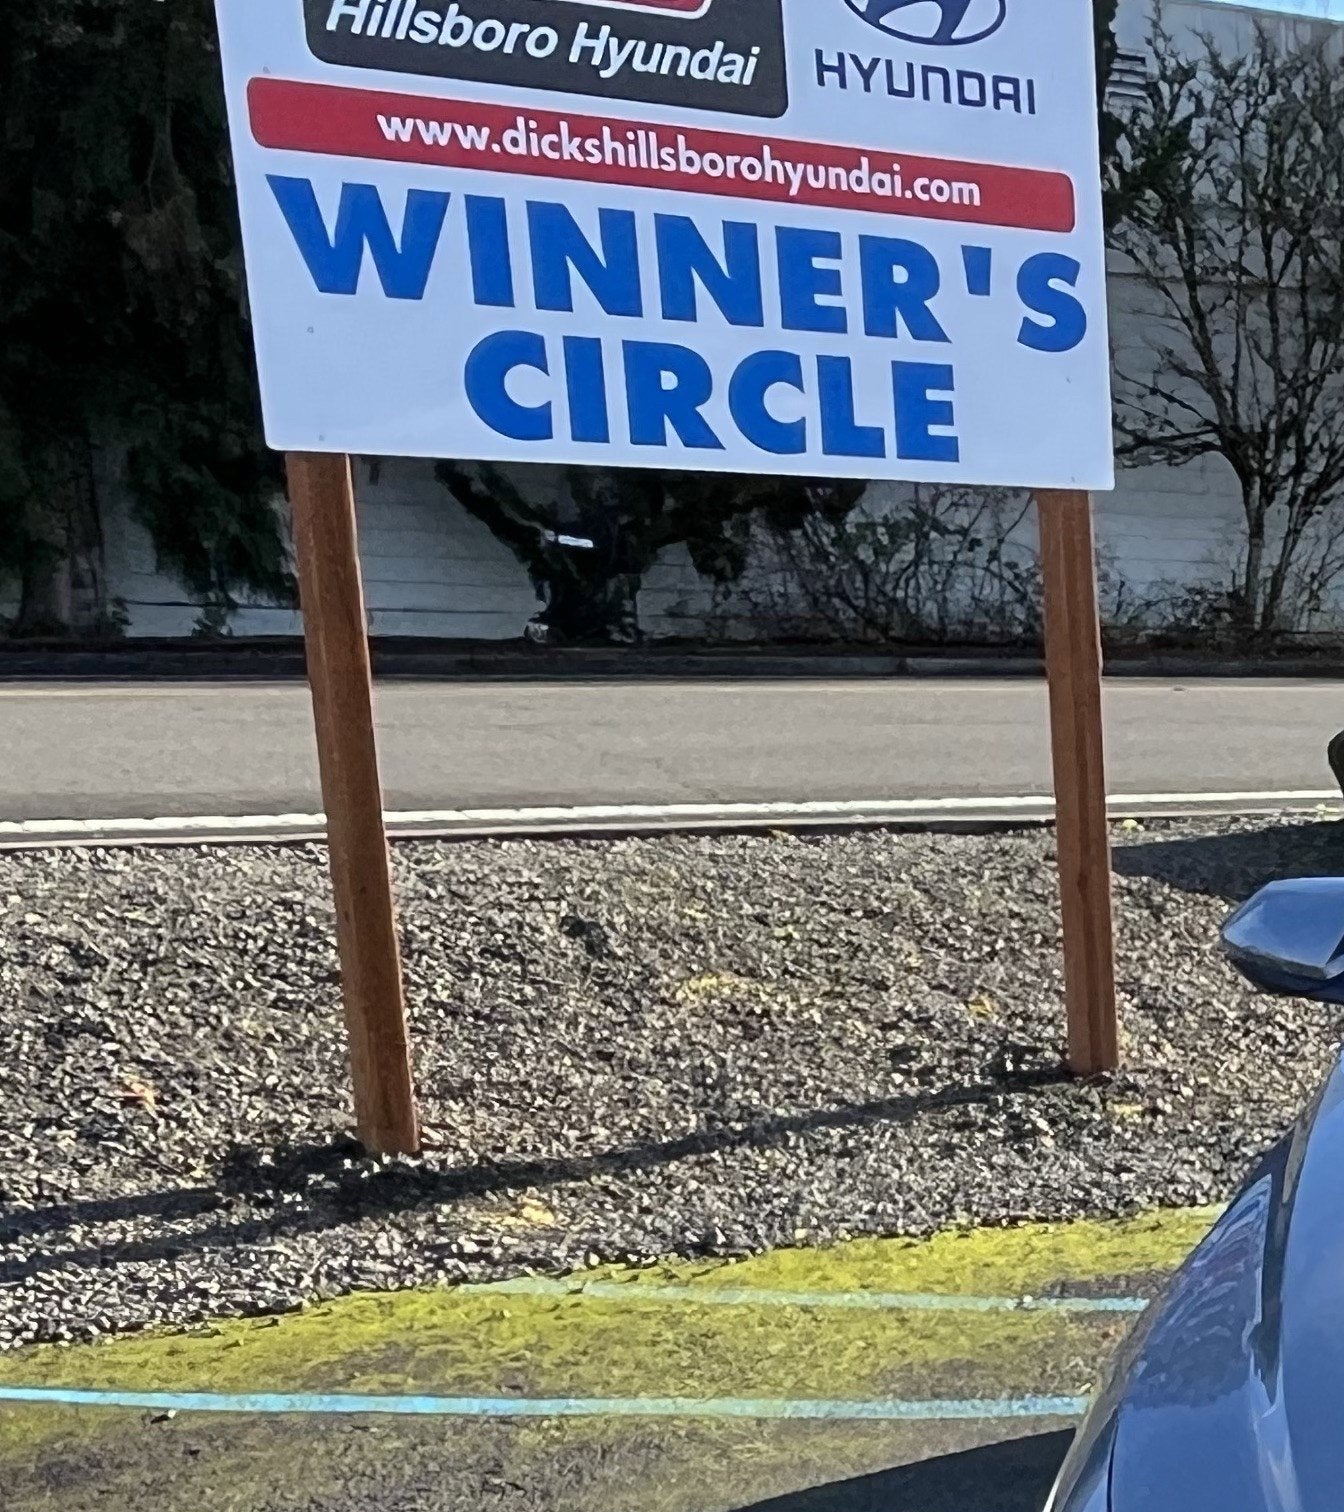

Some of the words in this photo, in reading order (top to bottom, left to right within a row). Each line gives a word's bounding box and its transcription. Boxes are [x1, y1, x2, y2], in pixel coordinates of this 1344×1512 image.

[325, 0, 558, 58] Hillsboro
[568, 22, 761, 86] Hyundai
[816, 48, 1036, 115] HYUNDAI
[377, 109, 981, 207] www.dickshillsborohyundai.com
[266, 174, 1087, 353] WINNER'S
[464, 330, 960, 464] CIRCLE
